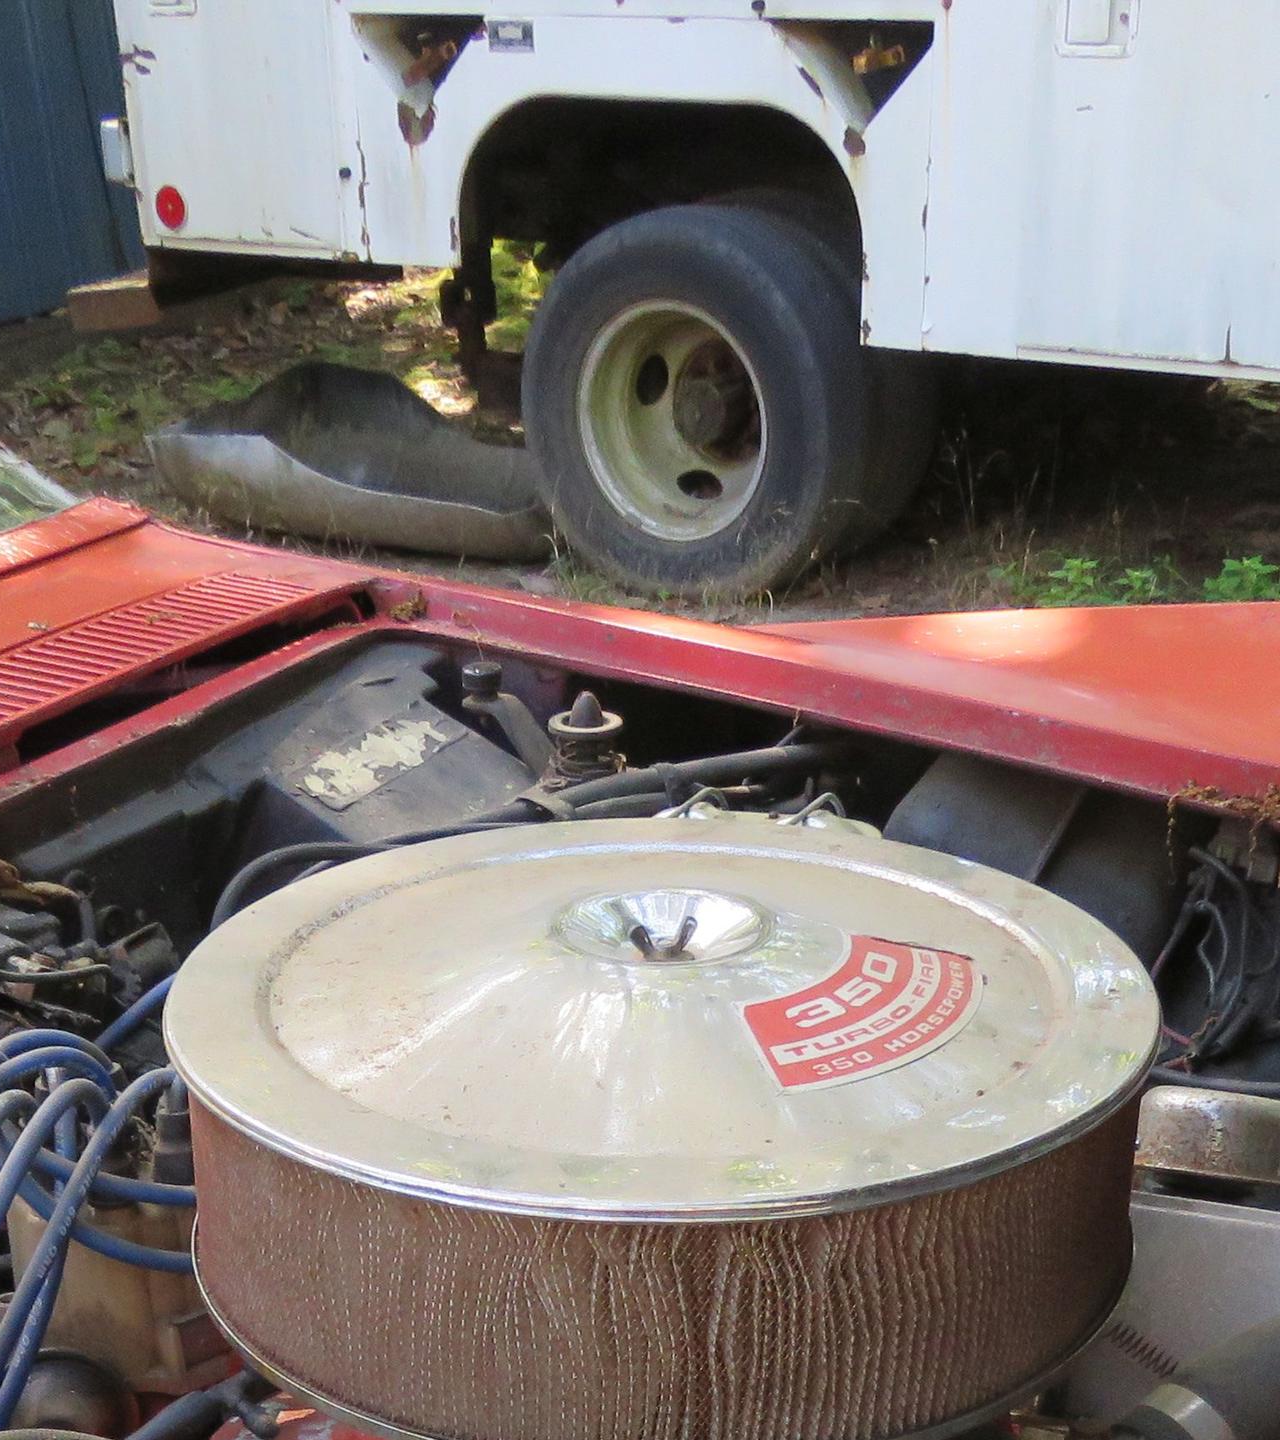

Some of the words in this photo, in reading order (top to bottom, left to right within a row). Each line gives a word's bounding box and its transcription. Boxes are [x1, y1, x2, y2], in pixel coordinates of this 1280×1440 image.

[784, 951, 934, 1056] TURBO-FIRE
[786, 951, 898, 1028] 350
[812, 1051, 873, 1076] 350
[883, 960, 965, 1052] HORSEPOWER
